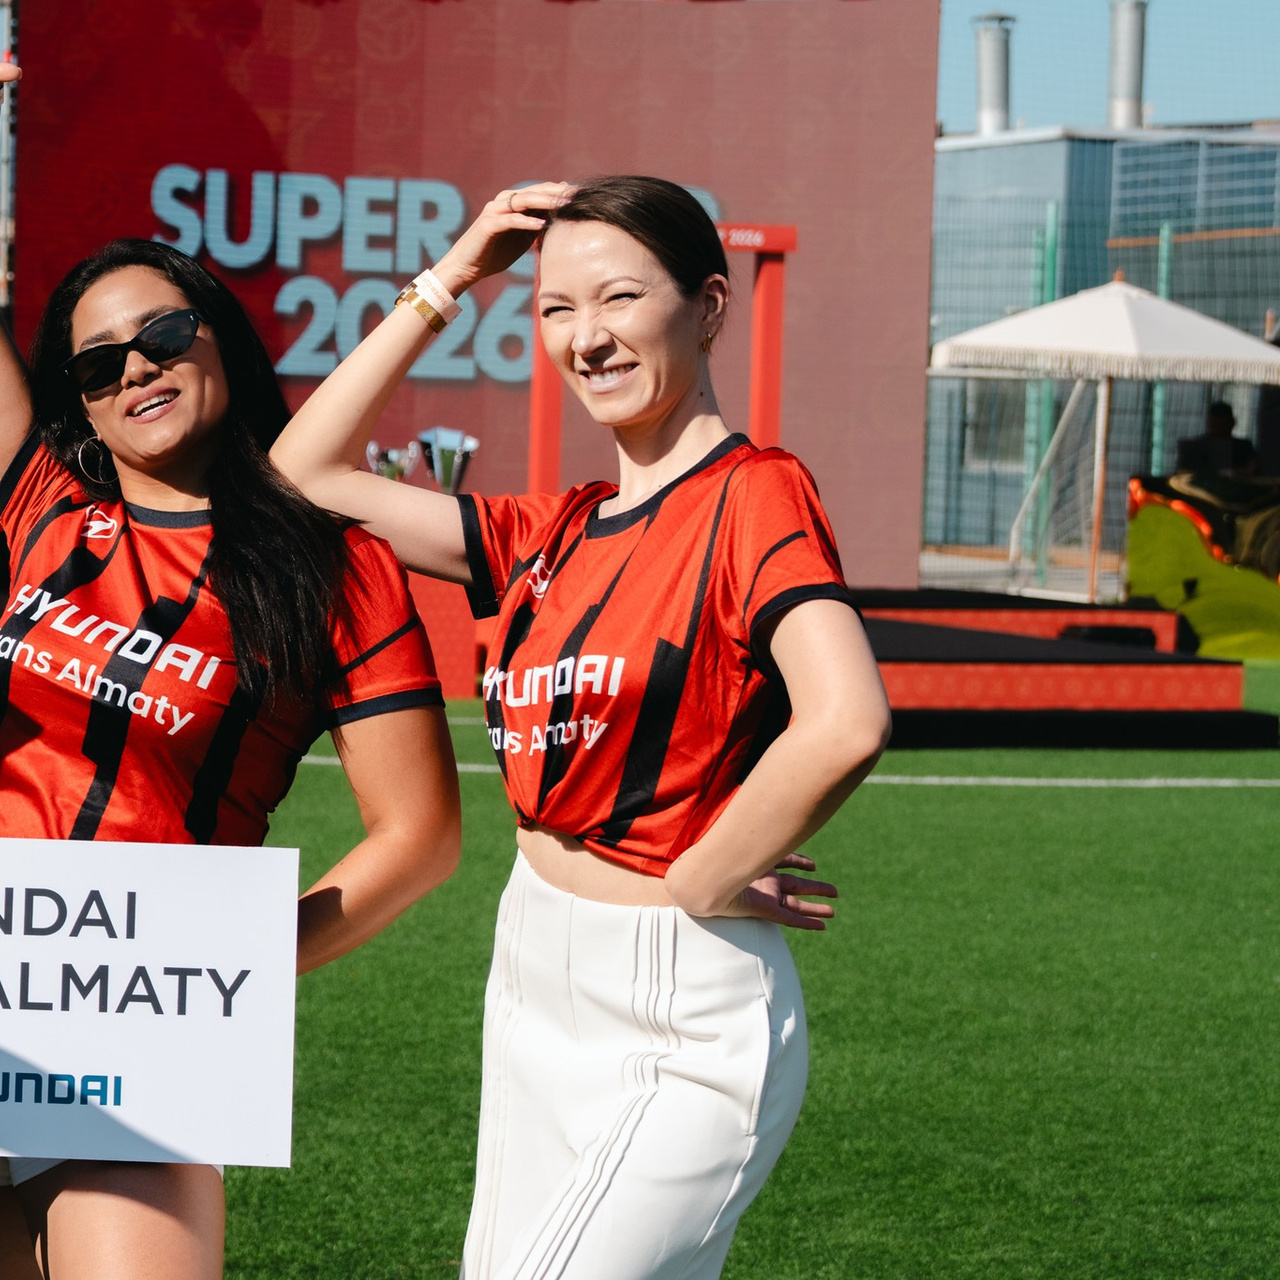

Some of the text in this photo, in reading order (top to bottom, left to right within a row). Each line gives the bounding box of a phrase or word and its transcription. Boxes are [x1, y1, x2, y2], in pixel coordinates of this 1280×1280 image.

[149, 162, 466, 275] SUPER
[6, 583, 222, 691] HYUNDAI
[56, 658, 196, 737] Almaty
